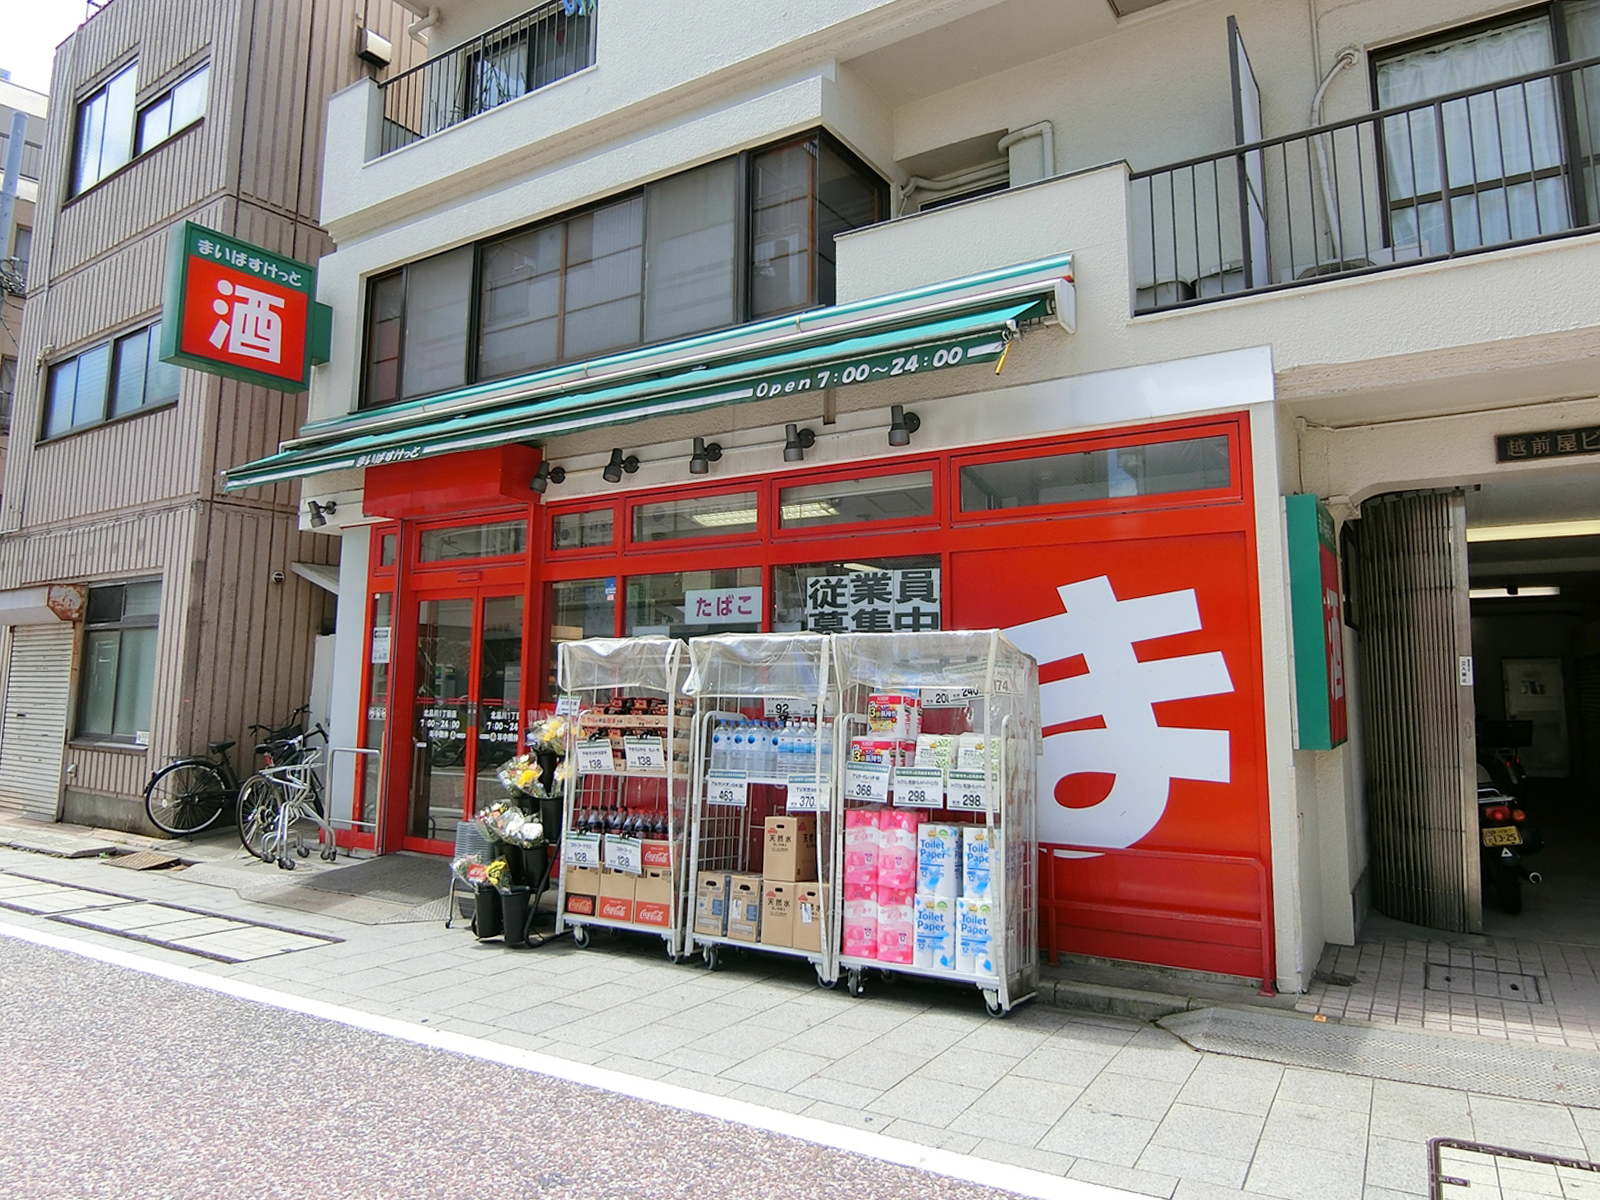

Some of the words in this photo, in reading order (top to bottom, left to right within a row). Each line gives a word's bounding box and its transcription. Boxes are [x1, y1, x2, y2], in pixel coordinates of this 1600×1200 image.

[198, 239, 302, 286] まいばすけっと
[209, 279, 285, 364] 酒
[756, 378, 810, 397] Open
[356, 446, 421, 467] まいばすけっと
[808, 570, 939, 609] 従業員
[696, 595, 752, 617] たばこ
[775, 703, 790, 713] 92
[1001, 575, 1235, 859] ま
[637, 756, 652, 766] 138
[855, 784, 872, 797] 368
[907, 790, 926, 802] 298
[800, 796, 815, 807] 370
[962, 794, 982, 807] 298
[920, 839, 945, 849] Toilet
[920, 849, 946, 861] Paper
[917, 911, 944, 922] Toilet
[961, 914, 987, 926] Toilet
[917, 921, 946, 933] Paper
[961, 924, 989, 936] Paper
